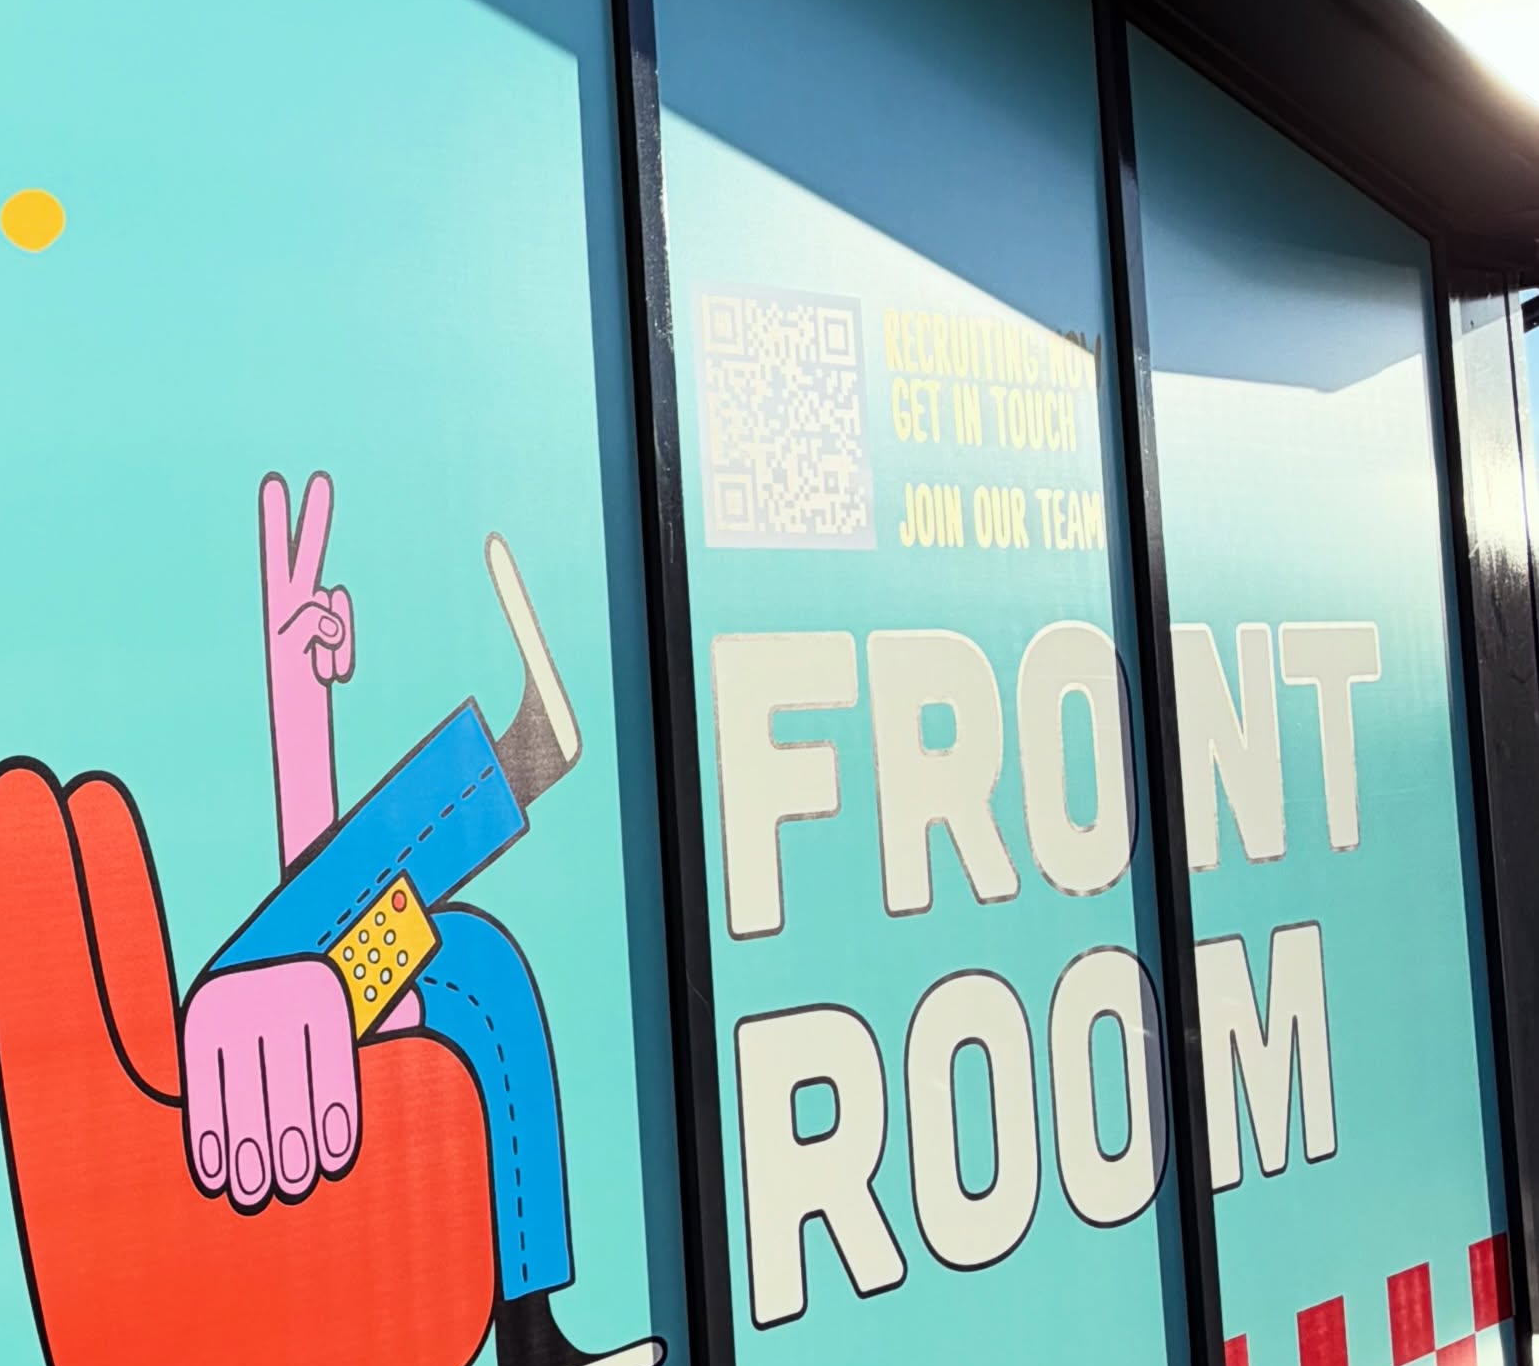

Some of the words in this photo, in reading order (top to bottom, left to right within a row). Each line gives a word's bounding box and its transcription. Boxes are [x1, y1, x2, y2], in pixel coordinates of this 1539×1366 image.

[883, 308, 1039, 386] RECRUITING
[891, 377, 941, 444] GET
[953, 382, 983, 447] IN
[990, 386, 1078, 452] TOUCH
[899, 482, 964, 549] JOIN
[973, 484, 1030, 550] OUR
[1035, 488, 1105, 551] TEAM
[710, 620, 1381, 941] FRONT
[734, 920, 1338, 1330] ROOM
